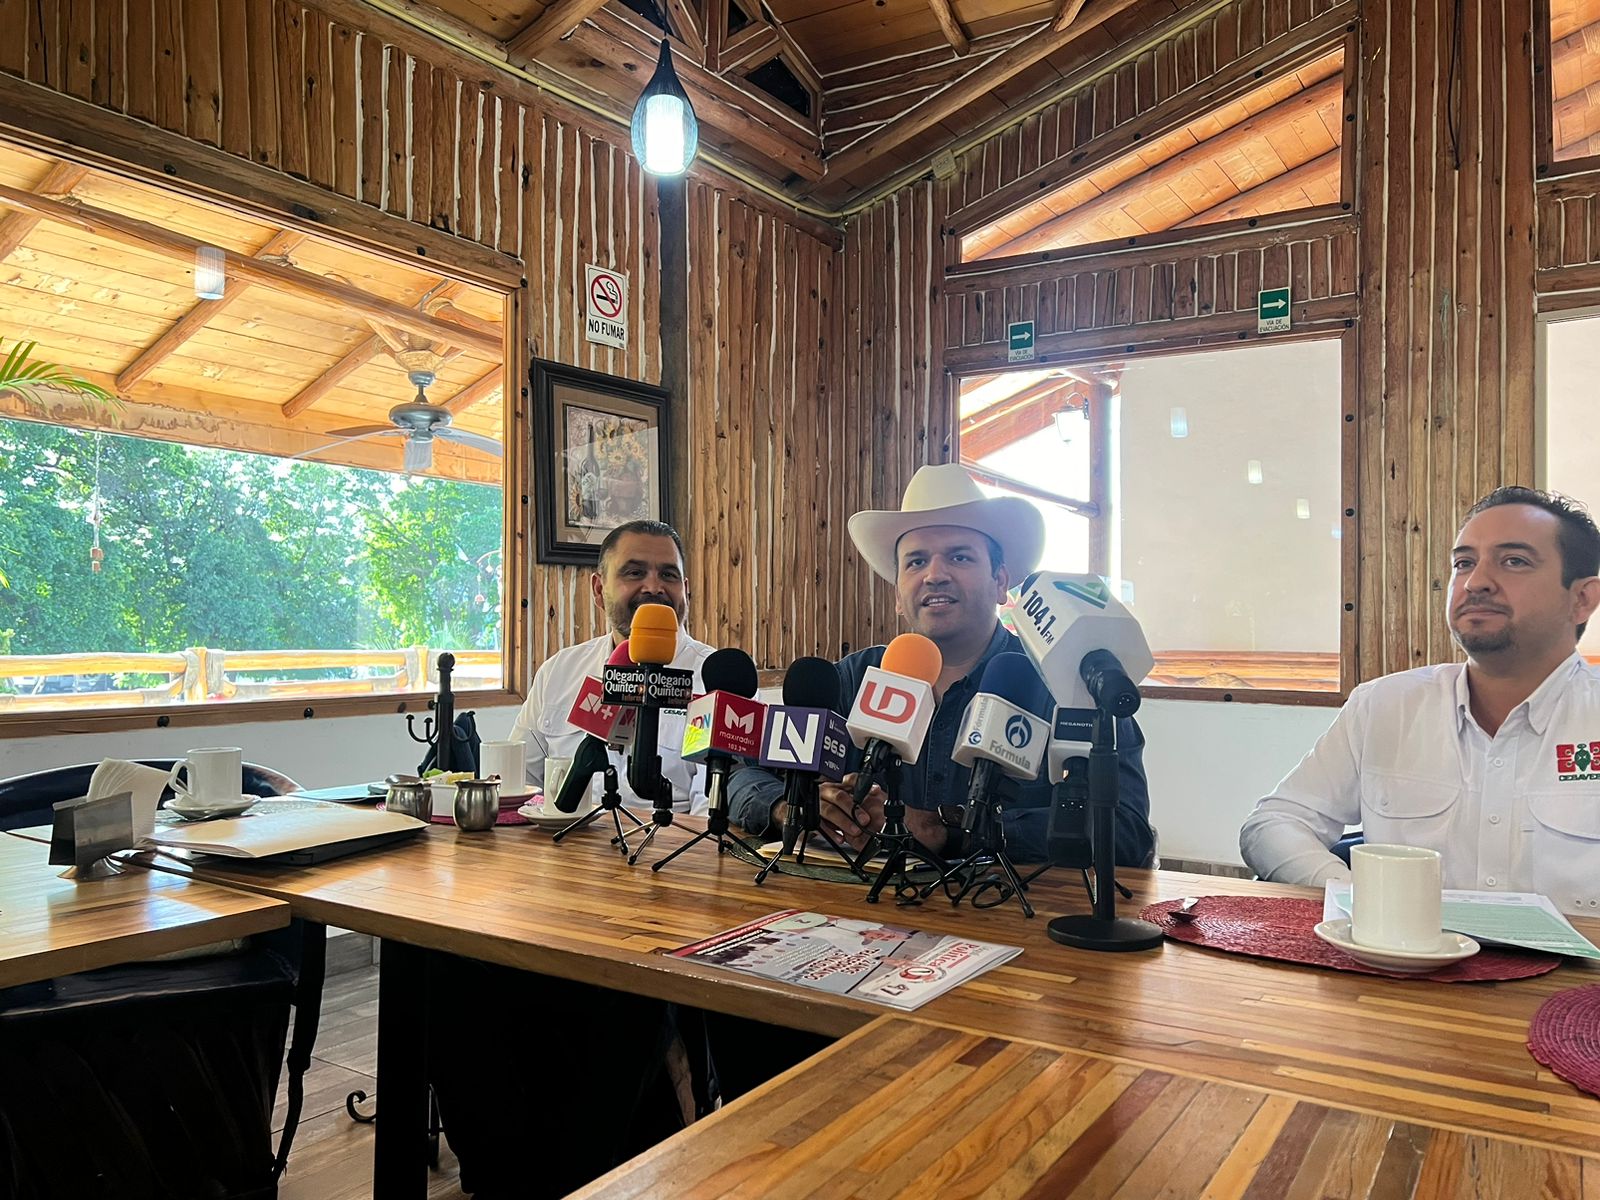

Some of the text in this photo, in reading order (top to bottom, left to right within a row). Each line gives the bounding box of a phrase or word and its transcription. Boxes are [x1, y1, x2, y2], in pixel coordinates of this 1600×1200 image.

[588, 319, 625, 341] NO FUMAR
[1022, 589, 1056, 645] 104.1 FM
[605, 669, 645, 684] Olegario
[648, 673, 691, 688] Olegario
[719, 730, 755, 746] maxiradio
[823, 735, 846, 759] 96.9
[989, 739, 1031, 770] Fórmula
